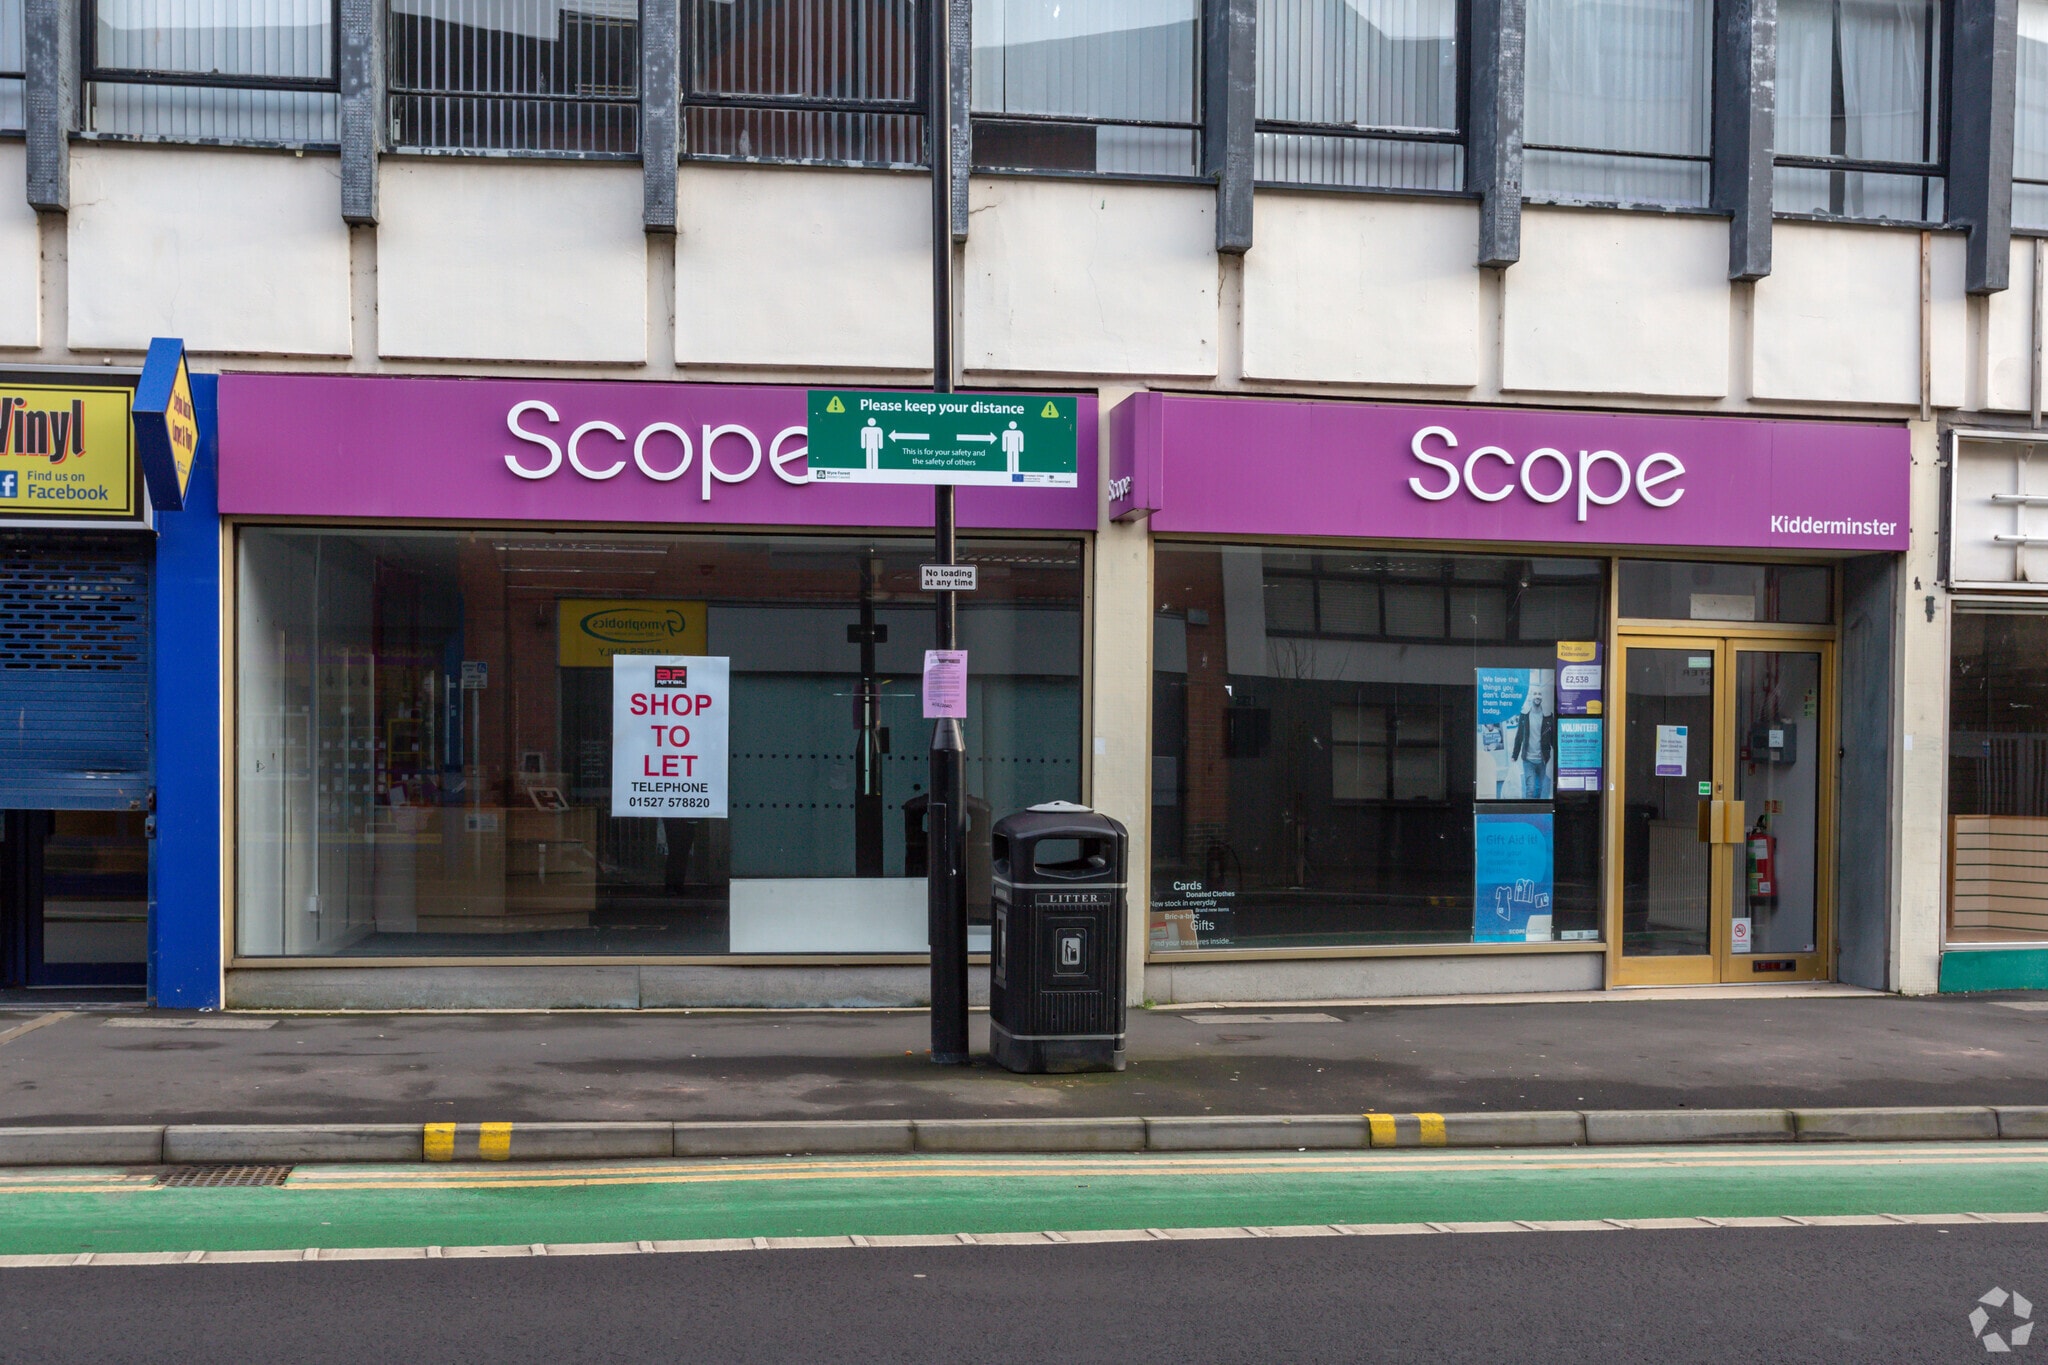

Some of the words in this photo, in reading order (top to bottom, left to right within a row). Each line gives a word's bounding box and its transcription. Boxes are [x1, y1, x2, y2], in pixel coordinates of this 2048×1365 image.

[860, 398, 901, 412] Please
[904, 400, 936, 415] keep
[939, 402, 968, 416] your
[971, 401, 1024, 414] distance
[504, 400, 808, 500] Scope
[952, 449, 972, 457] safety
[925, 458, 945, 466] safety
[28, 470, 52, 481] Find
[55, 473, 68, 482] us
[71, 473, 85, 482] on
[1408, 426, 1686, 521] Scope
[28, 484, 108, 500] Facebook
[1771, 515, 1897, 536] Kidderminster
[925, 569, 938, 577] No
[940, 569, 972, 579] loading
[1566, 676, 1589, 684] £2,538
[630, 693, 712, 716] SHOP
[1561, 723, 1598, 732] VOLUNTEER
[650, 725, 690, 747] TO
[644, 754, 698, 777] LET
[631, 782, 708, 792] TELEPHONE
[629, 797, 664, 807] 01527
[668, 798, 710, 808] 578820
[1486, 834, 1505, 845] Gift
[1508, 834, 1524, 845] Aid
[1173, 881, 1202, 890] Cards
[1189, 899, 1217, 907] everyday
[1190, 920, 1215, 930] Gifts
